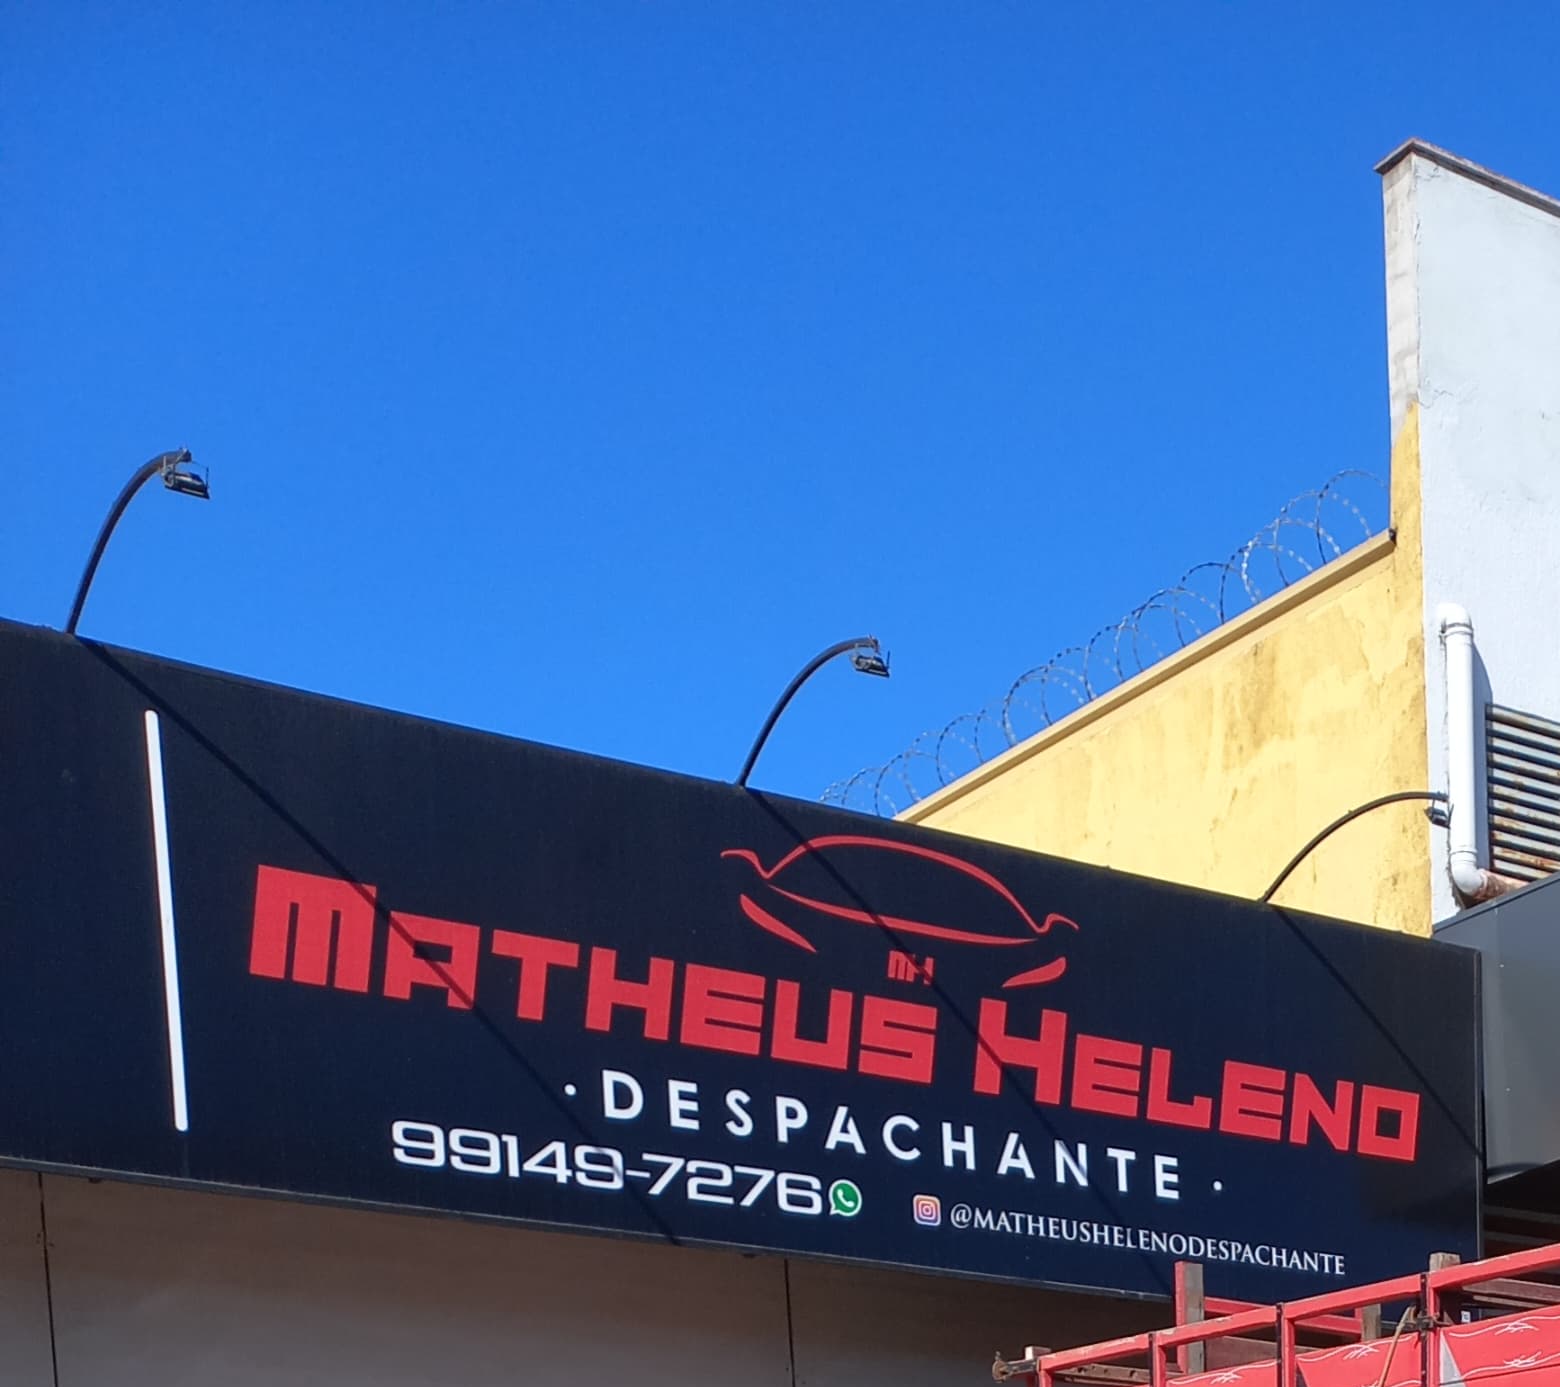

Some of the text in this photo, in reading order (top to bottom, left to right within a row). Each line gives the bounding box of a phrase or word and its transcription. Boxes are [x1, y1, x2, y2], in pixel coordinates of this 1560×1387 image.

[249, 864, 1420, 1162] MATHEUS HELENO
[391, 1120, 823, 1217] 99149-7276
[602, 1069, 1181, 1200] DESPACHANTE
[948, 1204, 1347, 1276] @MATHEUSHELENODESPACHANTE
